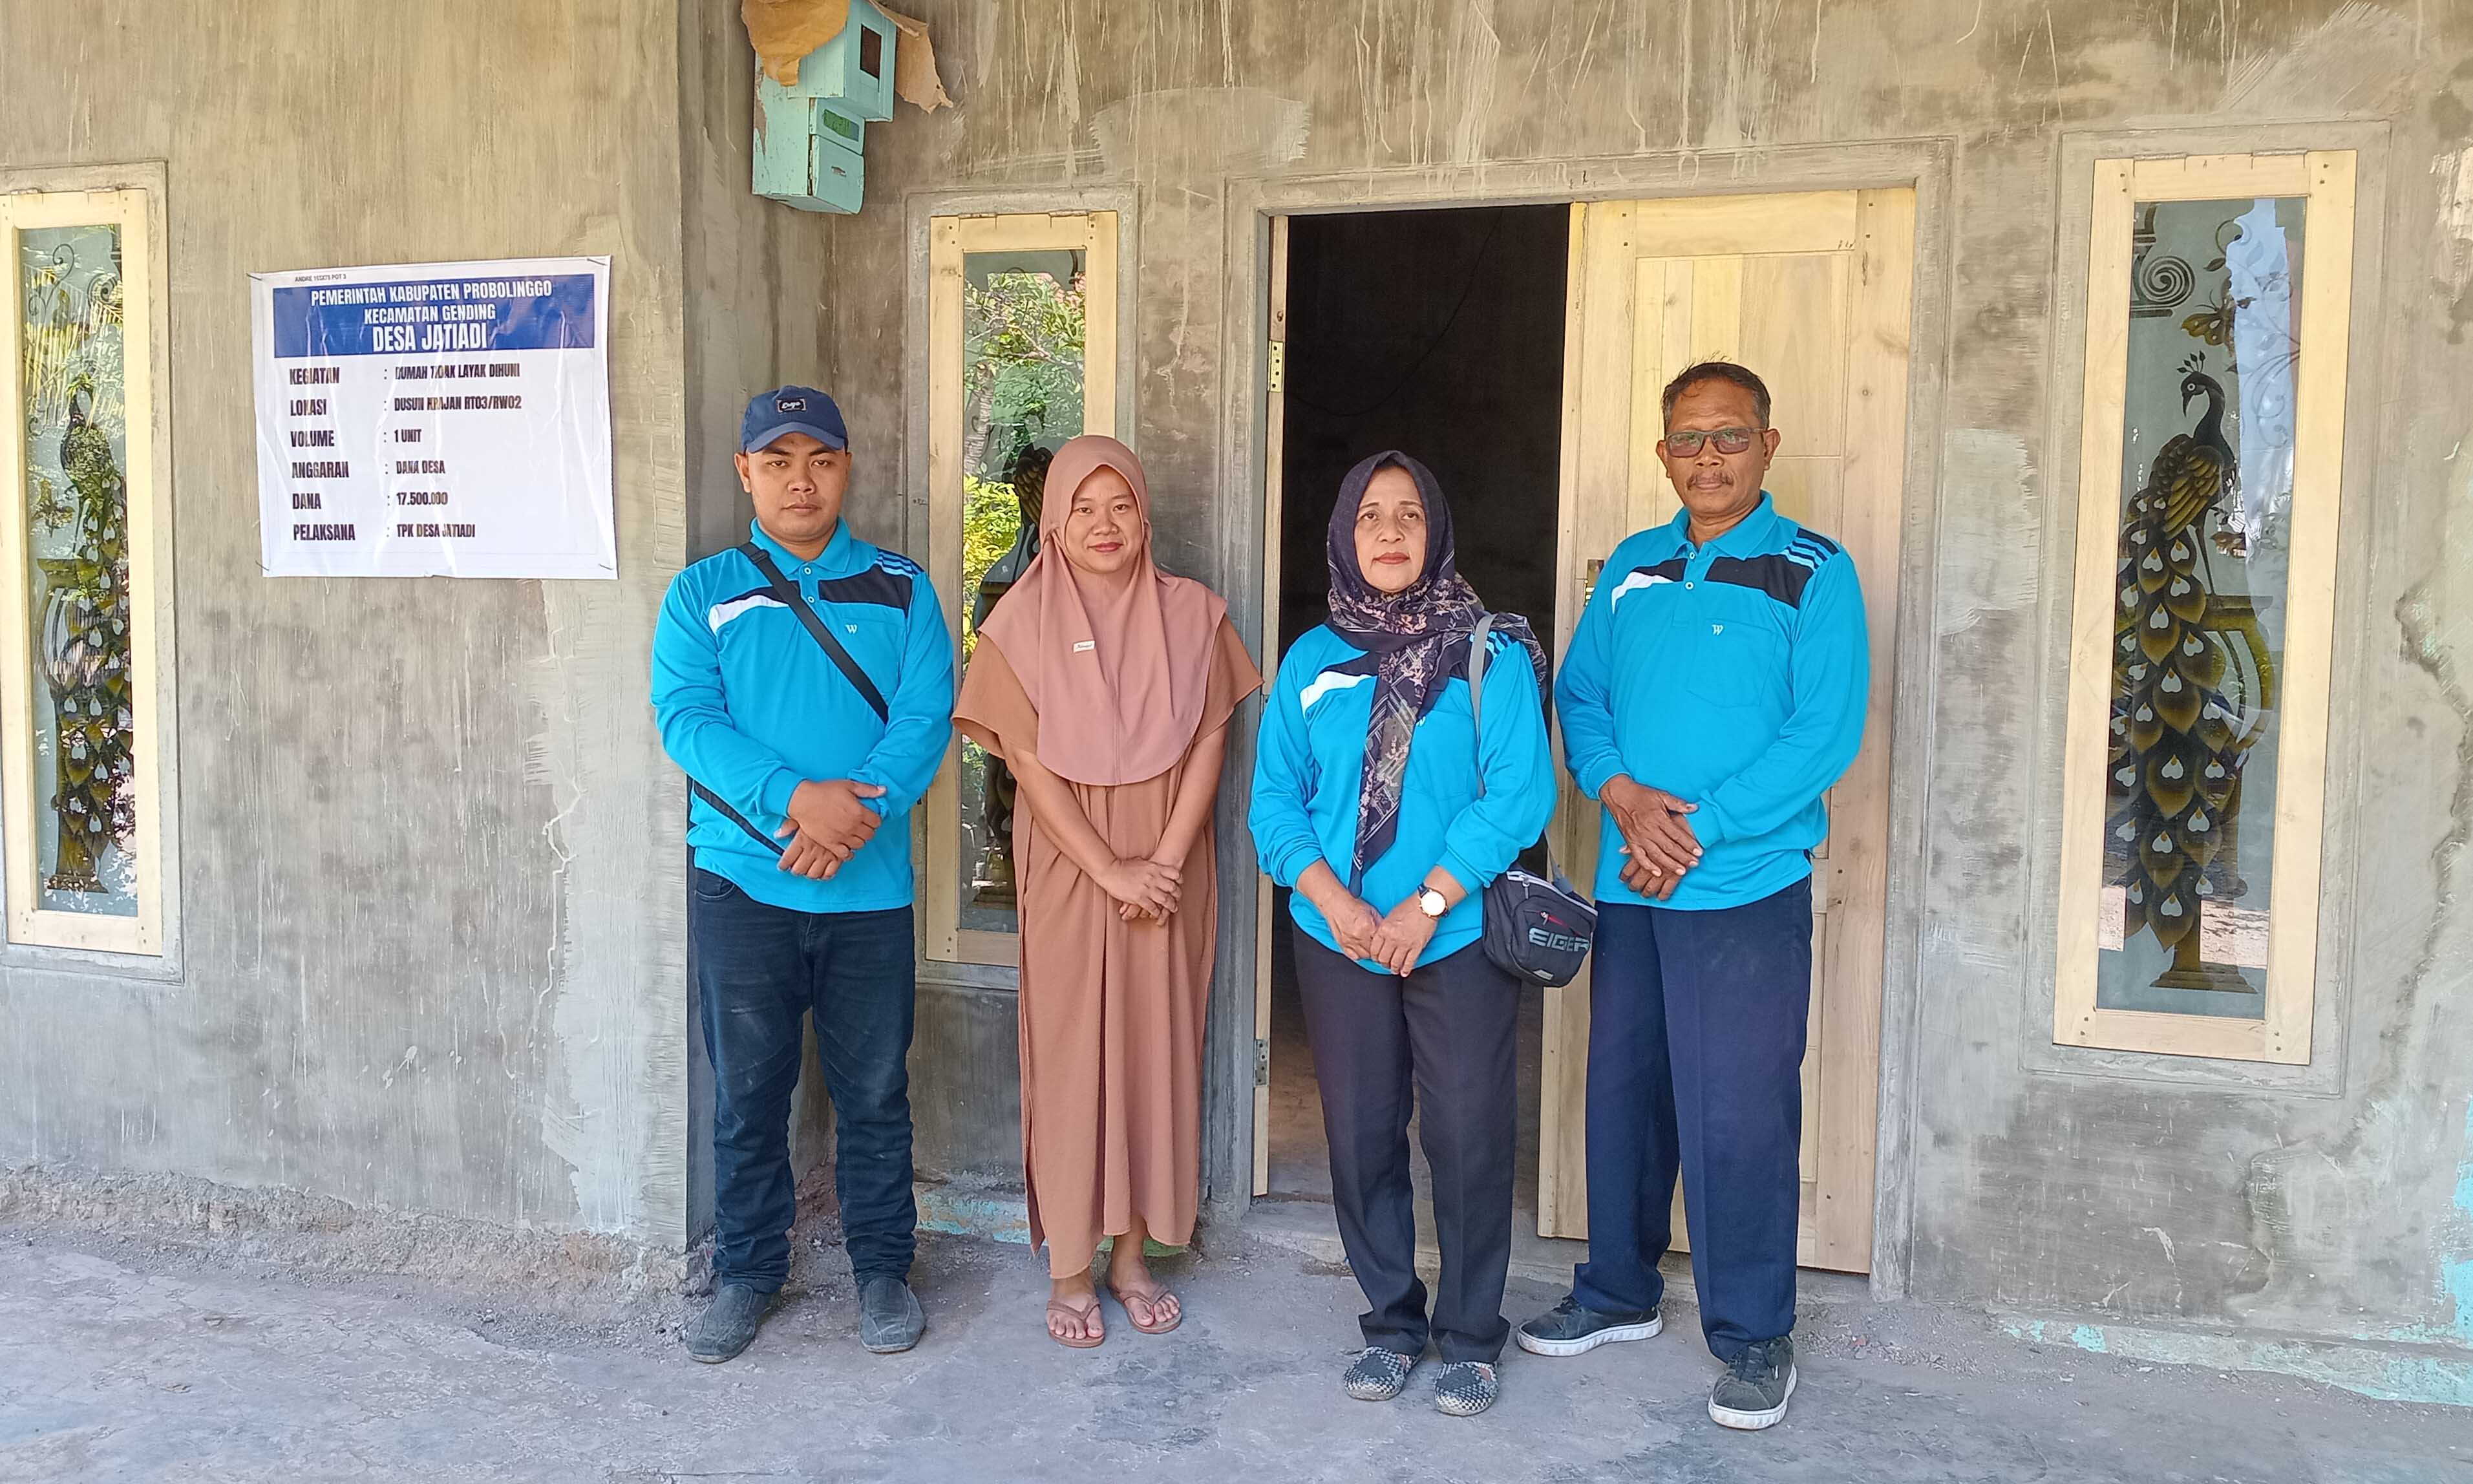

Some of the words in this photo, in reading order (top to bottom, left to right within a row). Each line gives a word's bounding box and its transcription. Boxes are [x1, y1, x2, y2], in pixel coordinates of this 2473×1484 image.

[310, 286, 387, 306] PEMERINTAH
[389, 282, 460, 302] KABUPATEN
[463, 279, 552, 299] PROBOLINGGO
[364, 305, 439, 324] KECAMATAN
[442, 304, 496, 321] GENDING
[372, 324, 417, 352] DESA
[421, 323, 487, 351] JATIADI
[290, 367, 340, 385] KEGIATAN
[458, 364, 487, 377] LAYAK
[489, 363, 520, 377] DIHUNI
[290, 399, 327, 416] LOKASI
[394, 397, 425, 411] DUSUN
[465, 396, 522, 410] RT03/RW02
[290, 430, 335, 447] VOLUME
[394, 429, 399, 443] 1
[401, 429, 421, 443] UNIT
[292, 461, 349, 478] ANGGARAN
[396, 460, 419, 474] DANA
[422, 460, 445, 474] DESA
[292, 493, 321, 509] DANA
[396, 492, 448, 505] 17.500.000
[293, 524, 356, 541] PELAKSANA
[397, 524, 414, 537] TPK
[416, 524, 440, 537] DESA
[442, 524, 476, 537] JATIADI
[1529, 927, 1590, 951] EIGER
